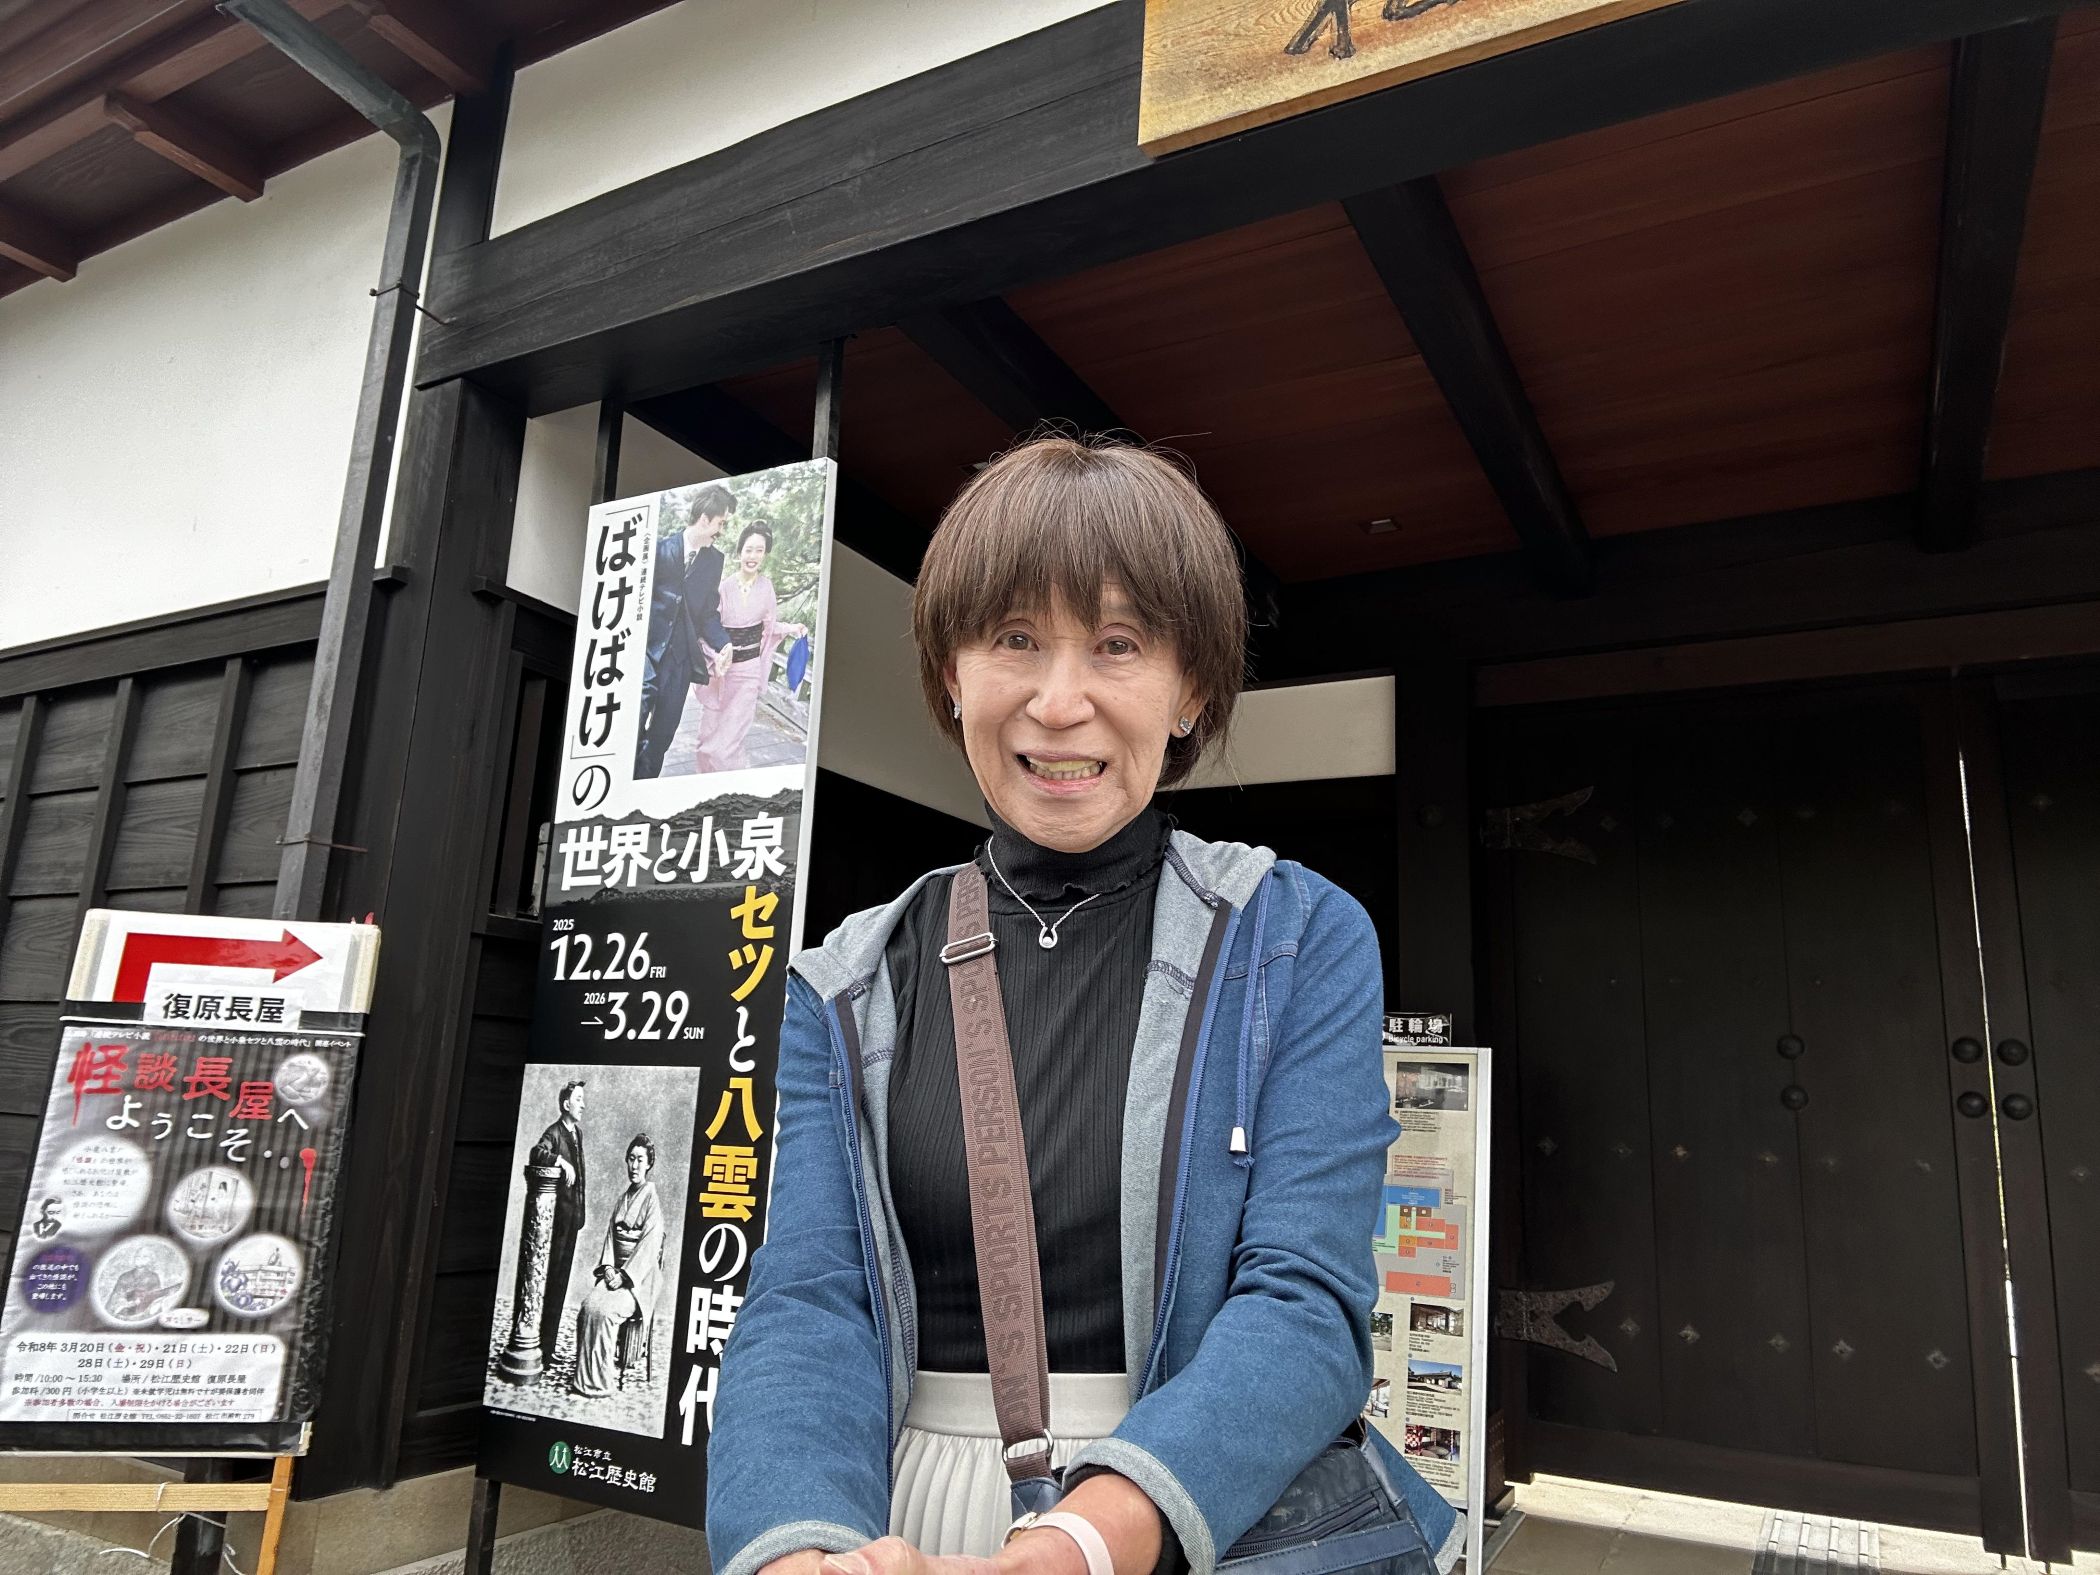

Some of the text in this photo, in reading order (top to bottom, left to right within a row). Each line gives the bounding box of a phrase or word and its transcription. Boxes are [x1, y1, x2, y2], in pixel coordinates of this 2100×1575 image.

[558, 812, 788, 891] 世界と小泉
[553, 918, 575, 931] 2025
[550, 932, 667, 981] 12.26 FRI
[956, 921, 992, 1015] SPOS
[163, 993, 285, 1023] 復原長屋
[584, 992, 606, 1005] 2026
[604, 990, 704, 1040] 3.29 SUN
[1388, 1035, 1443, 1045] Bicycle parking
[964, 1018, 1009, 1166] PERSON'S
[978, 1174, 1026, 1323] SPORTS
[17, 1341, 57, 1353] 令和8年
[571, 1457, 657, 1493] 松江歴史館
